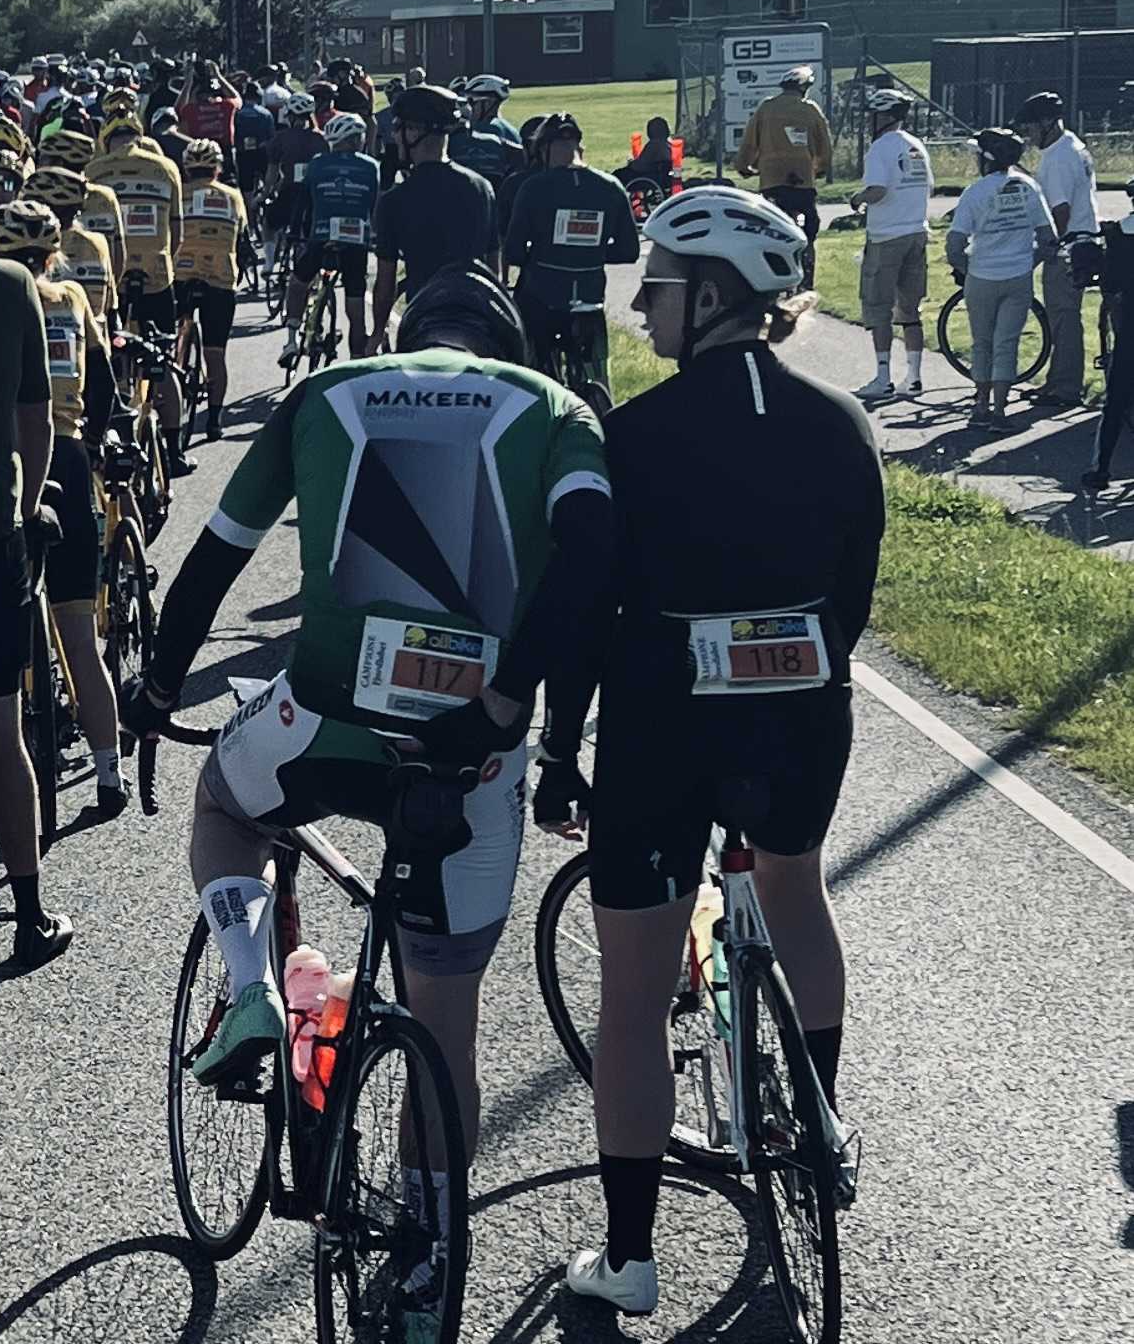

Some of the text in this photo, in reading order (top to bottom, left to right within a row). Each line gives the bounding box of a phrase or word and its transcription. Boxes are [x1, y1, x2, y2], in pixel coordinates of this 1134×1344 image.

[366, 390, 492, 408] MAKEEN
[749, 645, 801, 673] 118
[417, 657, 466, 691] 117
